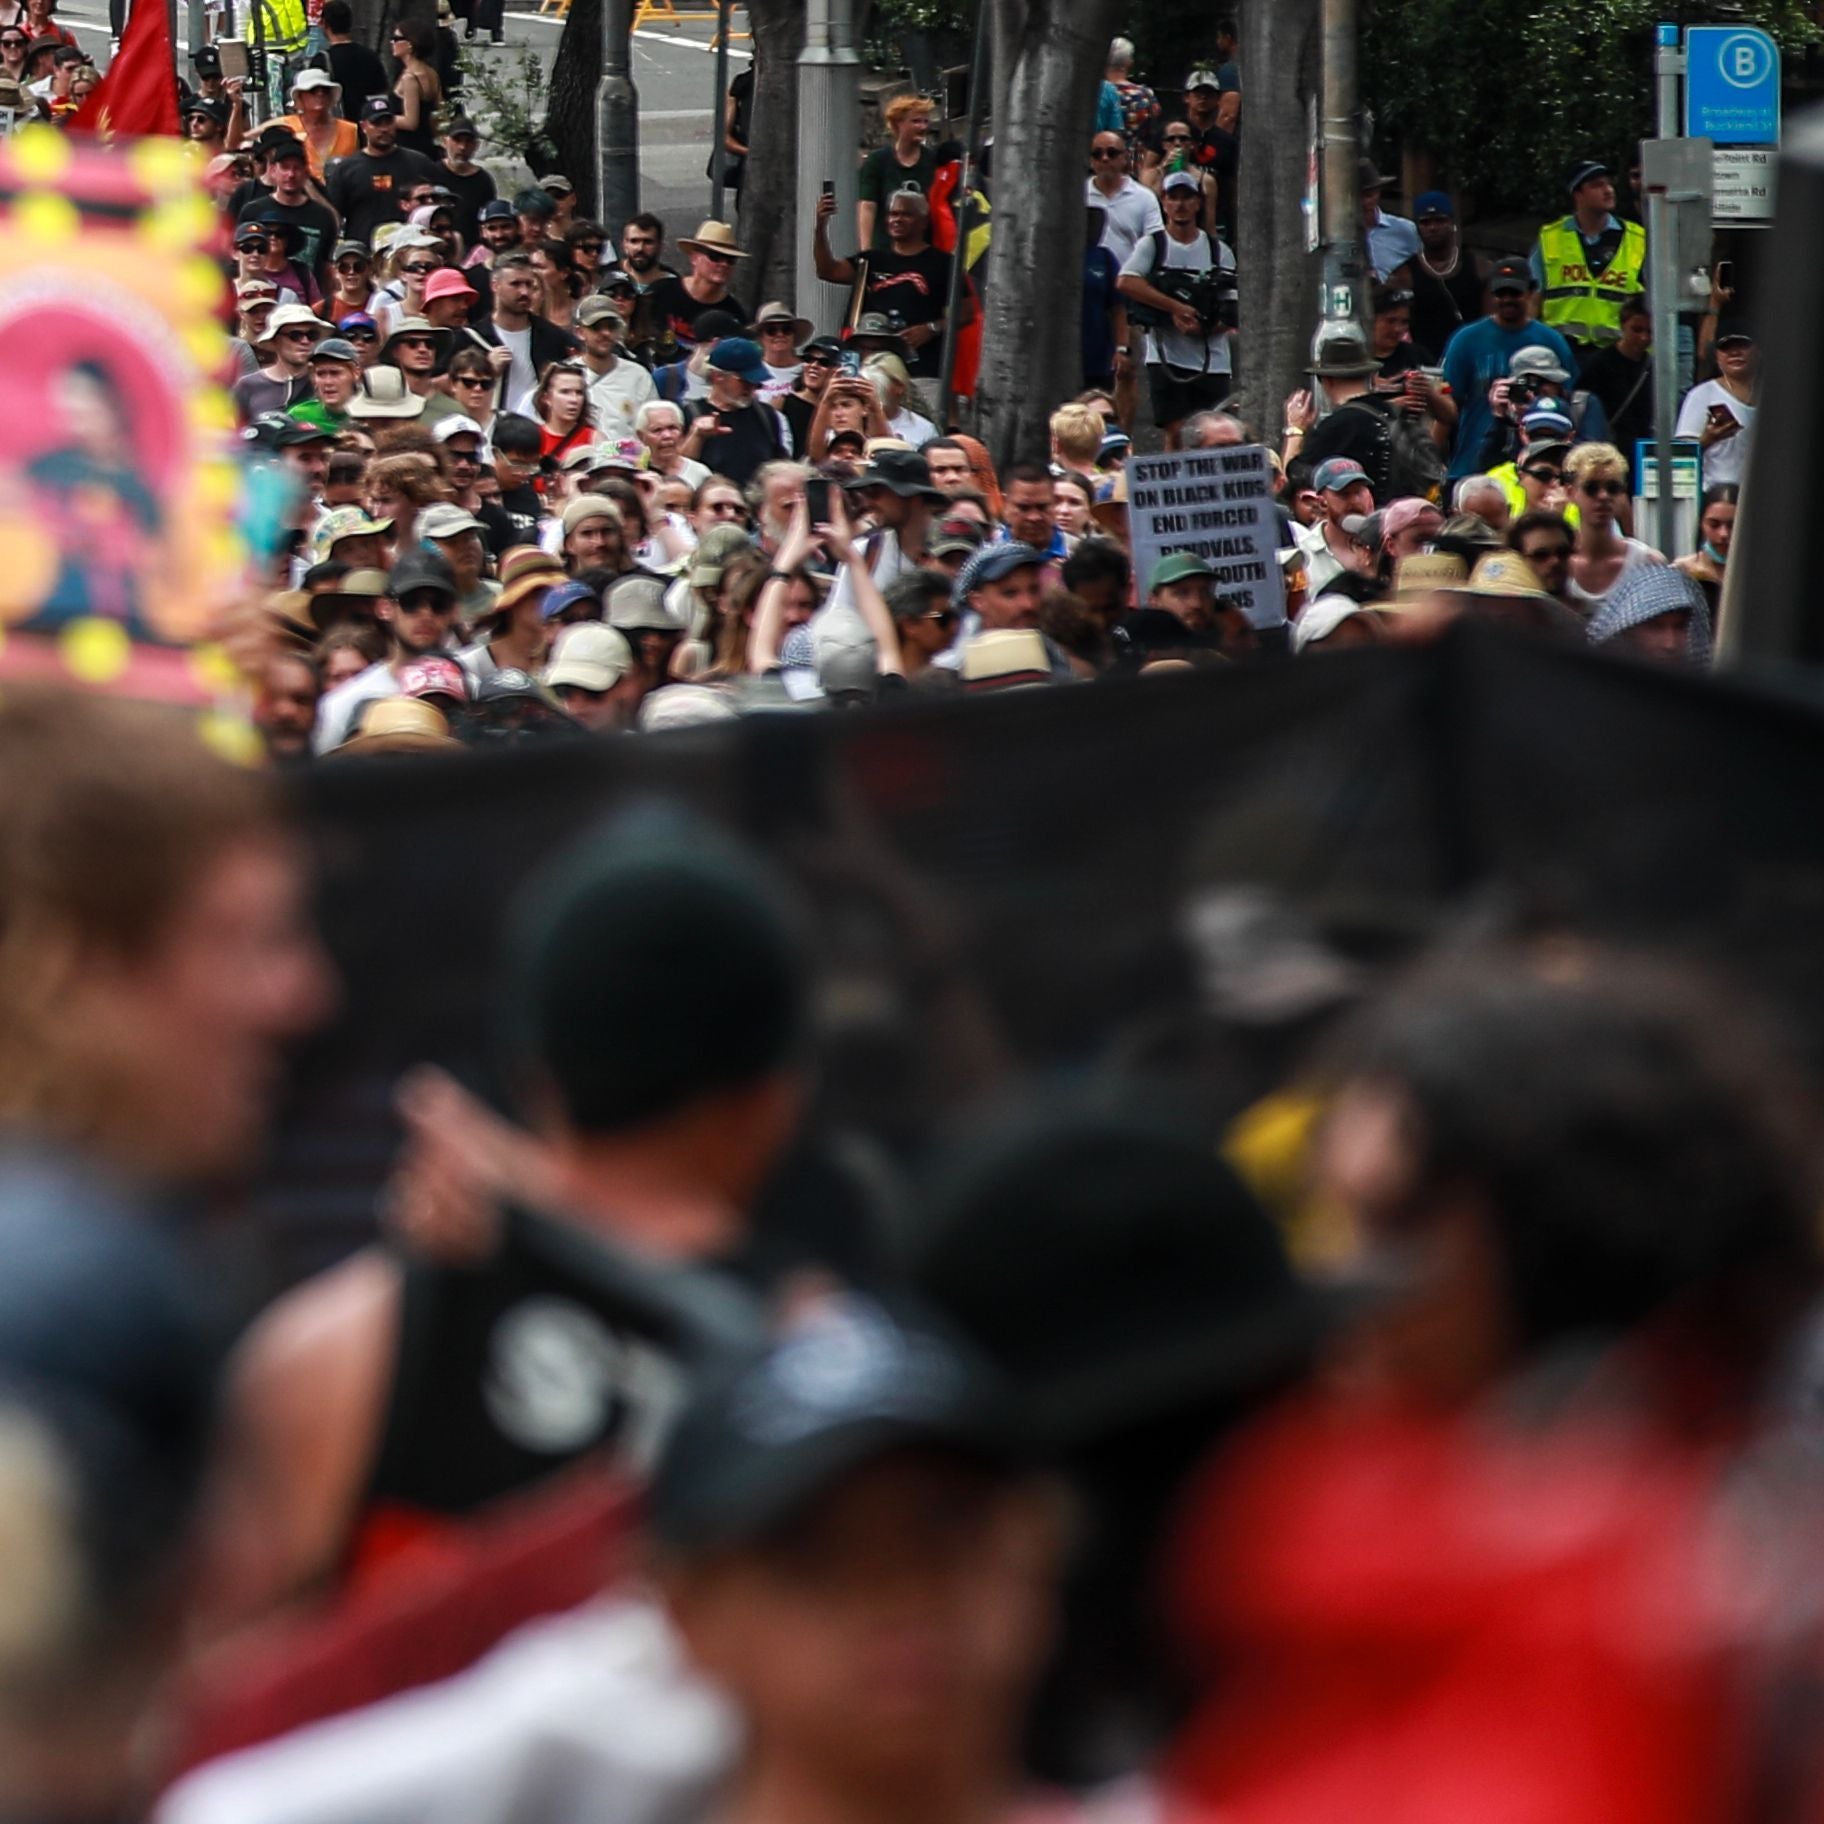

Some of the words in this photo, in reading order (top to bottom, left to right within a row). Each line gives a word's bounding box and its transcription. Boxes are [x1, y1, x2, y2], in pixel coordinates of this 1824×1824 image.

[1734, 46, 1756, 77] B
[1752, 153, 1768, 165] Rd
[1751, 186, 1767, 198] Rd
[1334, 292, 1351, 310] H
[1135, 461, 1182, 482] STOP
[1183, 458, 1216, 477] THE
[1221, 453, 1264, 473] WAR
[1133, 489, 1160, 509] ON
[1163, 484, 1221, 506] BLACK
[1223, 480, 1267, 499] KIDS
[1152, 513, 1189, 534] END
[1190, 507, 1258, 528] FORCED
